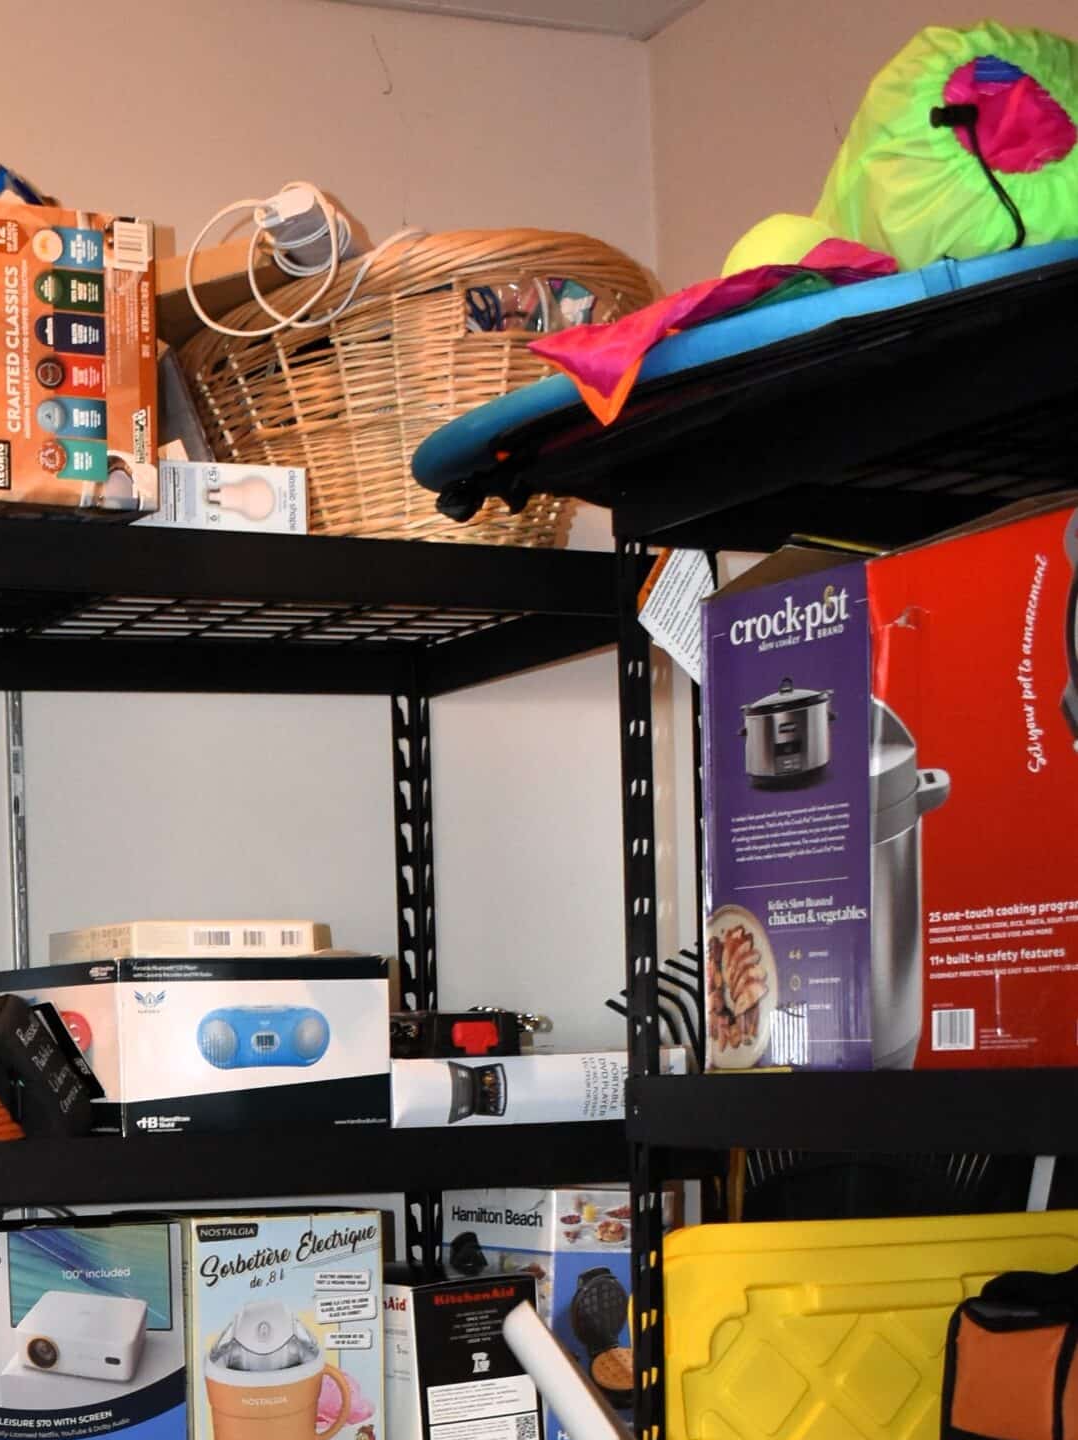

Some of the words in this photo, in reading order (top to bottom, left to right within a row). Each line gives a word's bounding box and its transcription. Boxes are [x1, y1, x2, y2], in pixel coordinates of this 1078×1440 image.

[4, 266, 20, 349] CLASSICS
[6, 352, 21, 433] CRAFTED
[288, 469, 298, 502] classic
[288, 504, 298, 531] shape
[1022, 554, 1048, 655] amazement
[817, 624, 844, 638] BRAND
[1017, 675, 1037, 700] pot
[1024, 704, 1044, 741] your
[768, 911, 806, 926] chicken
[807, 909, 816, 923] &
[817, 905, 867, 925] vegetables
[929, 911, 941, 923] 25
[942, 906, 994, 921] one-touch
[996, 903, 1037, 916] cooking
[946, 952, 984, 965] built-in
[986, 949, 1018, 963] safety
[1020, 948, 1066, 960] features
[598, 1057, 608, 1080] DVD
[609, 1061, 618, 1110] PORTABLE
[600, 1080, 609, 1117] PLAYER
[452, 1205, 502, 1224] Hamilton
[505, 1209, 543, 1227] Beach
[200, 1228, 255, 1237] NOSTALGIA
[85, 1266, 131, 1279] included
[200, 1247, 291, 1288] Sorbetière
[249, 1275, 263, 1289] de
[433, 1287, 515, 1305] KitchenAid
[53, 1417, 78, 1427] WITH
[78, 1409, 113, 1424] SCREEN
[10, 1430, 38, 1439] Licensed
